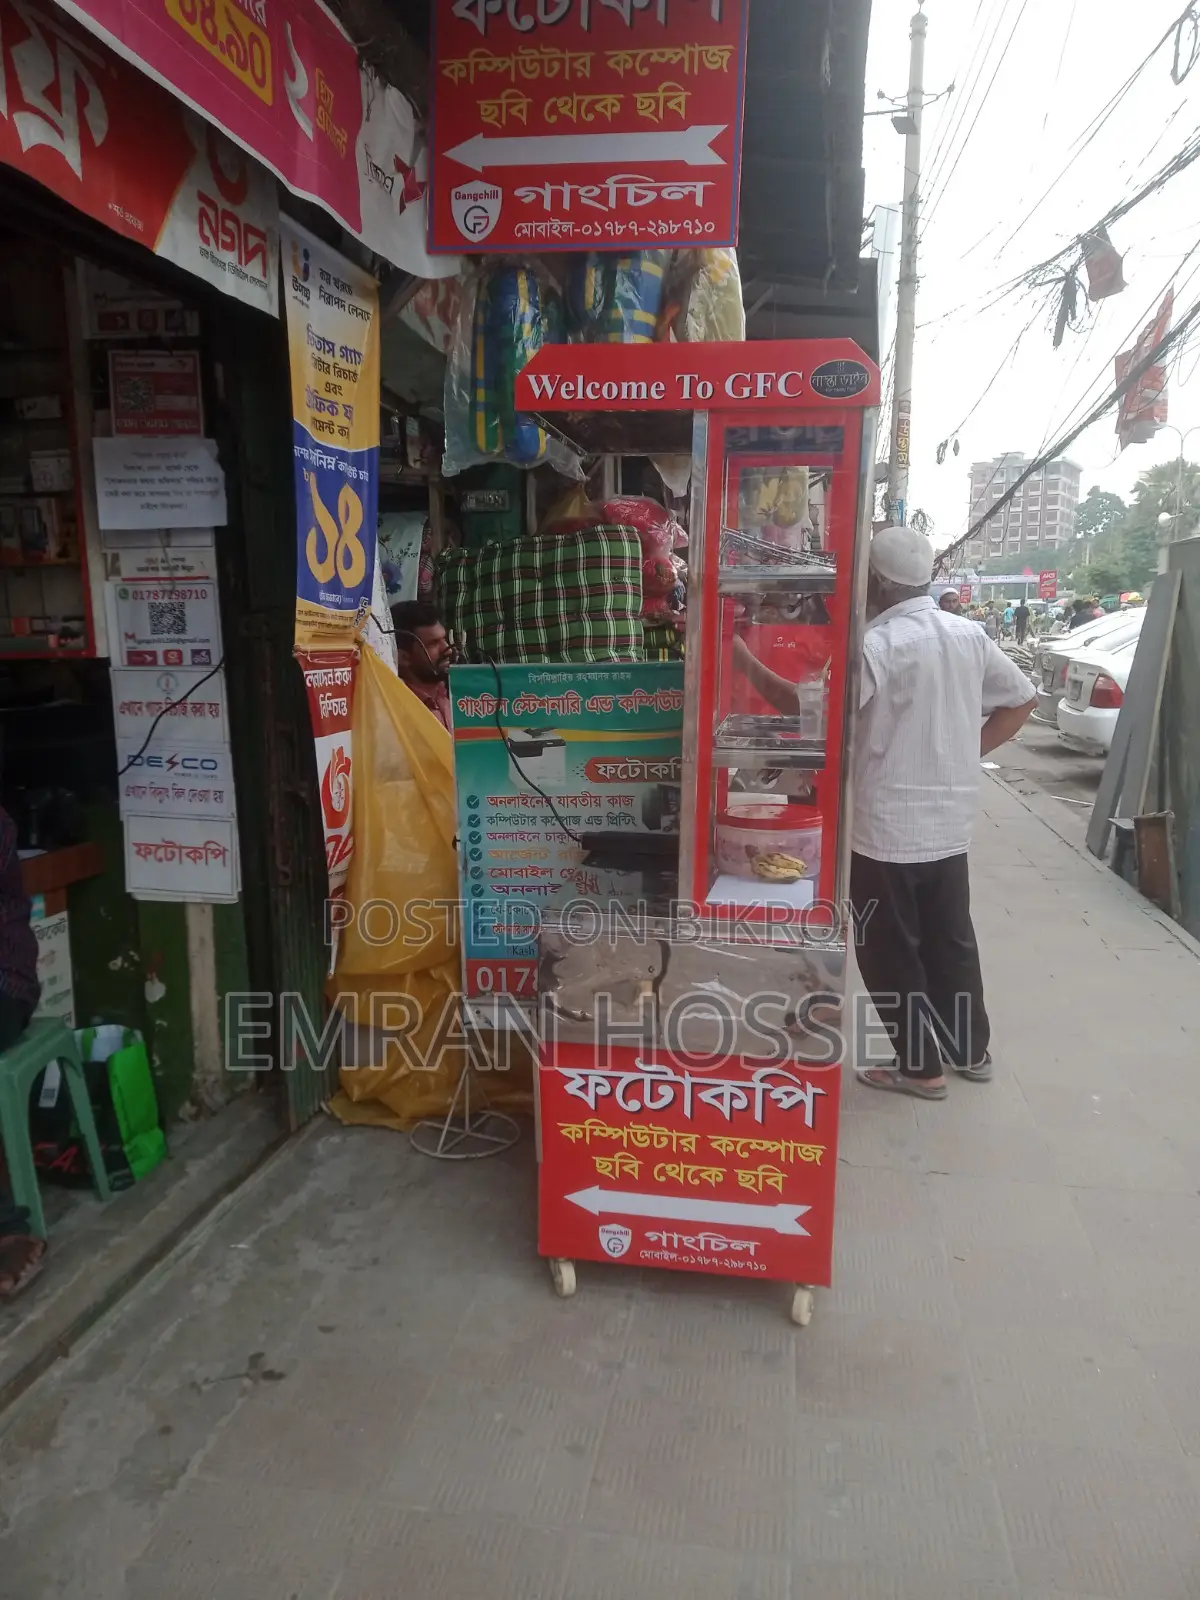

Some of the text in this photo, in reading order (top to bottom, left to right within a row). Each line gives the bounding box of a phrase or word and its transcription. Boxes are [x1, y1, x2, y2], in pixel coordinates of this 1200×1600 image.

[440, 42, 735, 85] কম্পিউটার কম্পোজ
[476, 82, 691, 129] ছবি থেকে ছবি
[455, 189, 499, 201] Gangchill
[513, 174, 716, 212] গাংচিল
[514, 217, 715, 239] মোবাইল-০১৭৮৭-২৯৮৭১০
[324, 381, 344, 397] এবং
[526, 370, 804, 401] Welcome To GFC
[457, 692, 508, 717] গাংচিল
[512, 689, 581, 716] স্টেশনারি
[606, 794, 636, 808] কাজ
[486, 812, 538, 827] কম্পিউটার
[132, 836, 228, 867] ফটোকপি
[488, 865, 554, 879] মোবাইল
[555, 1057, 826, 1128] ফটোকপি
[557, 1118, 826, 1166] কম্পিউটার কম্পোজ
[593, 1151, 788, 1195] ছবি থেকে ছবি
[645, 1230, 760, 1256] গাংচিল
